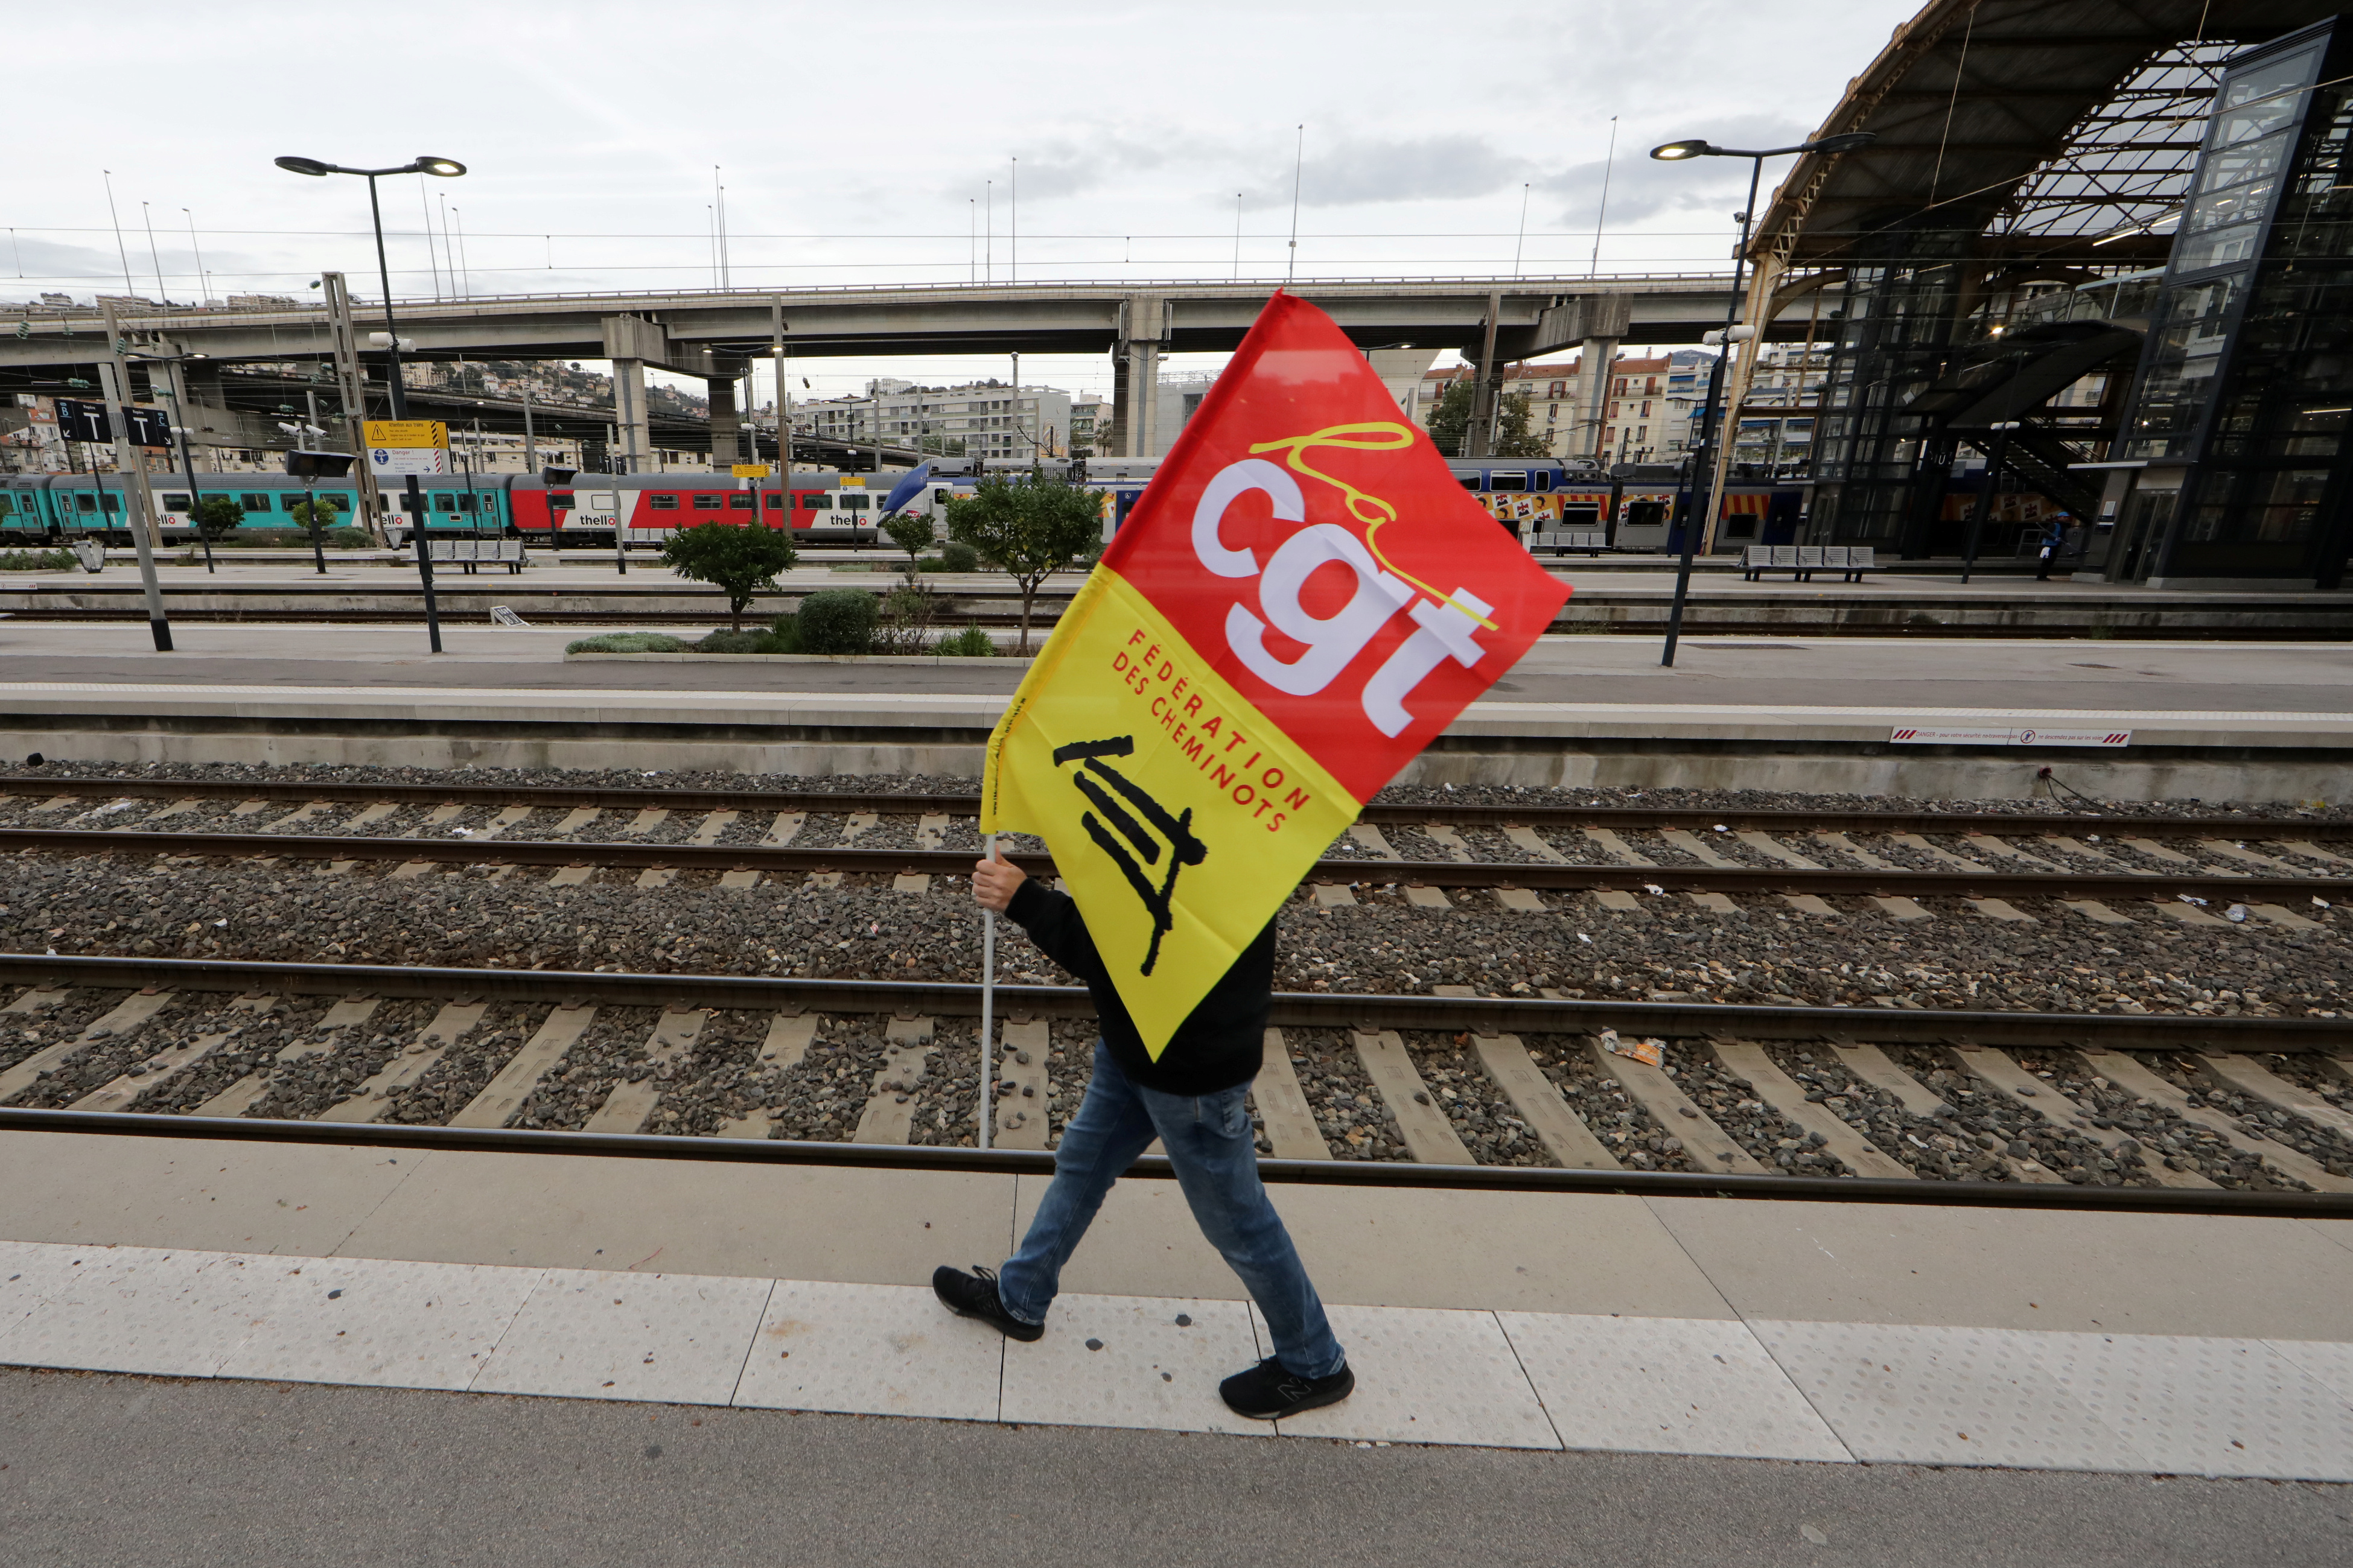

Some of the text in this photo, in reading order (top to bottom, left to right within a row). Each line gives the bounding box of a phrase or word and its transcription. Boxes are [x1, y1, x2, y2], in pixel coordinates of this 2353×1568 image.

[62, 407, 69, 416] B
[83, 412, 100, 440] T
[159, 417, 165, 425] C
[133, 417, 148, 443] T
[1191, 458, 1495, 738] cgt
[1112, 651, 1150, 695] DES
[1128, 629, 1311, 811] FÉDÉRATION
[1151, 697, 1287, 833] CHEMINOTS
